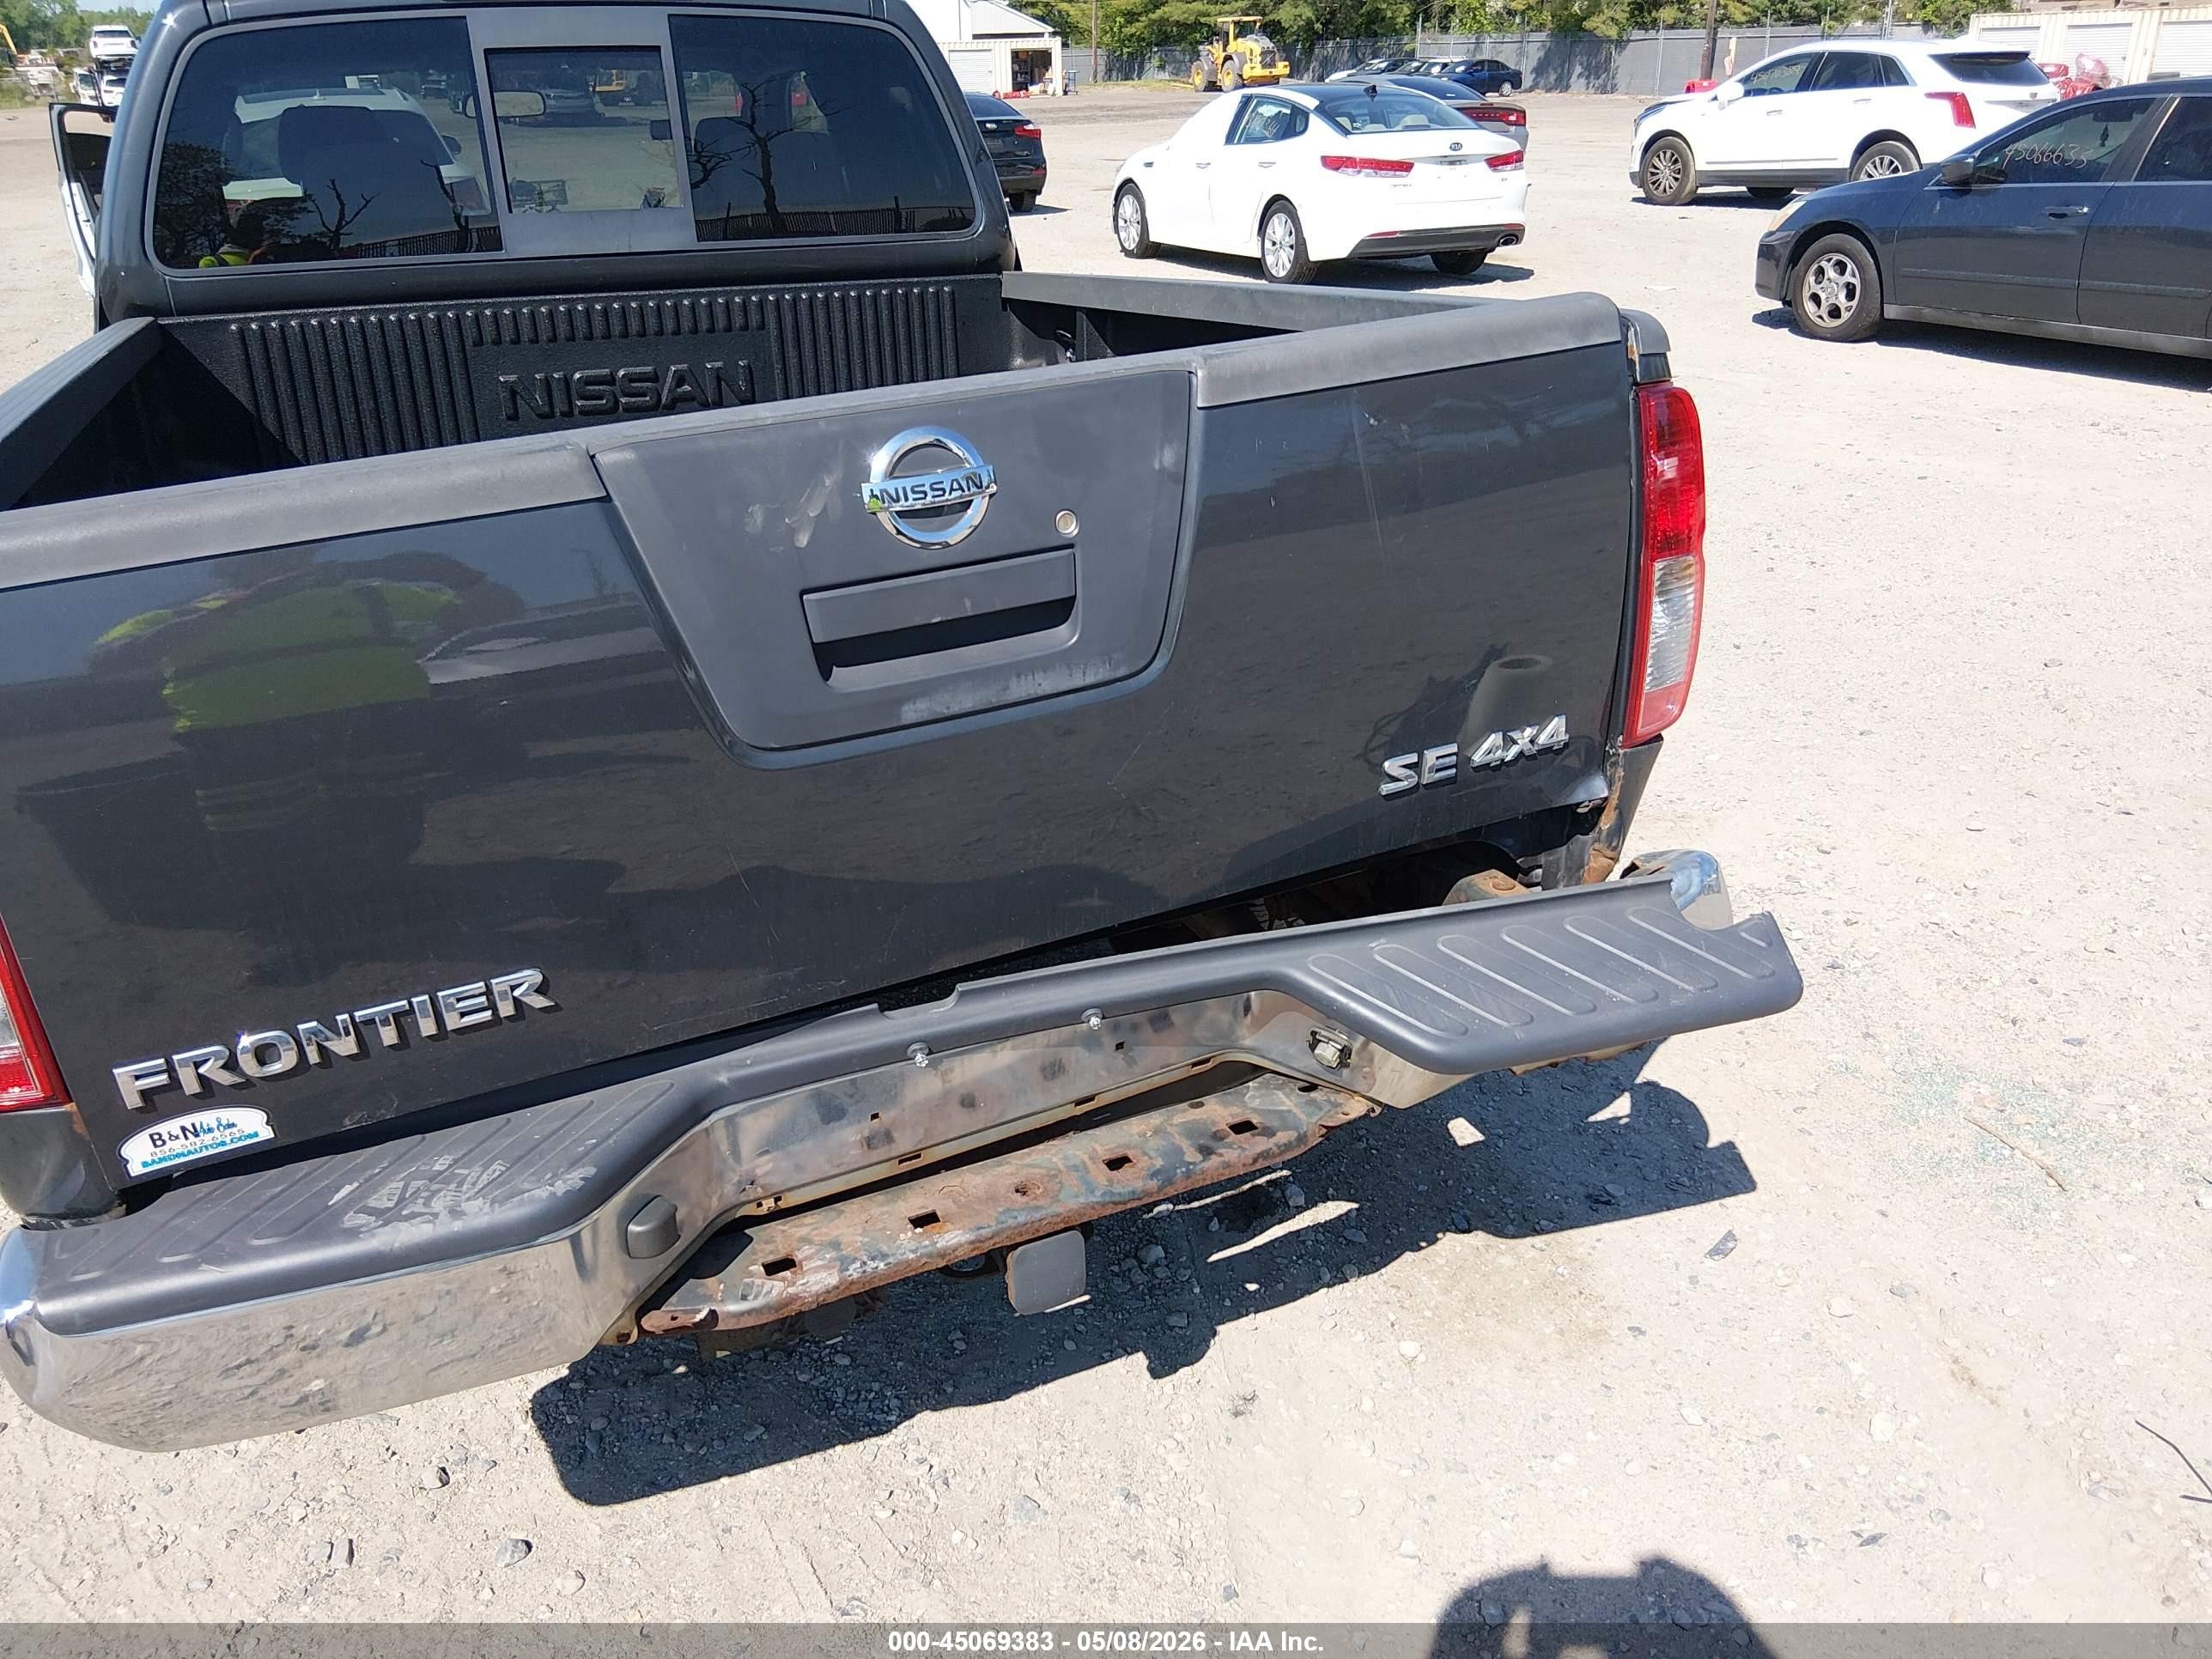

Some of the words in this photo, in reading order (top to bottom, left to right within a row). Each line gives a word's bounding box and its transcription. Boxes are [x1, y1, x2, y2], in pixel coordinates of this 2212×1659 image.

[498, 360, 757, 422] NISSAN
[879, 473, 983, 505] NISSAN
[1378, 743, 1458, 796] SE
[112, 968, 555, 1109] FRONTIER
[149, 1128, 246, 1158] 856-582-6565
